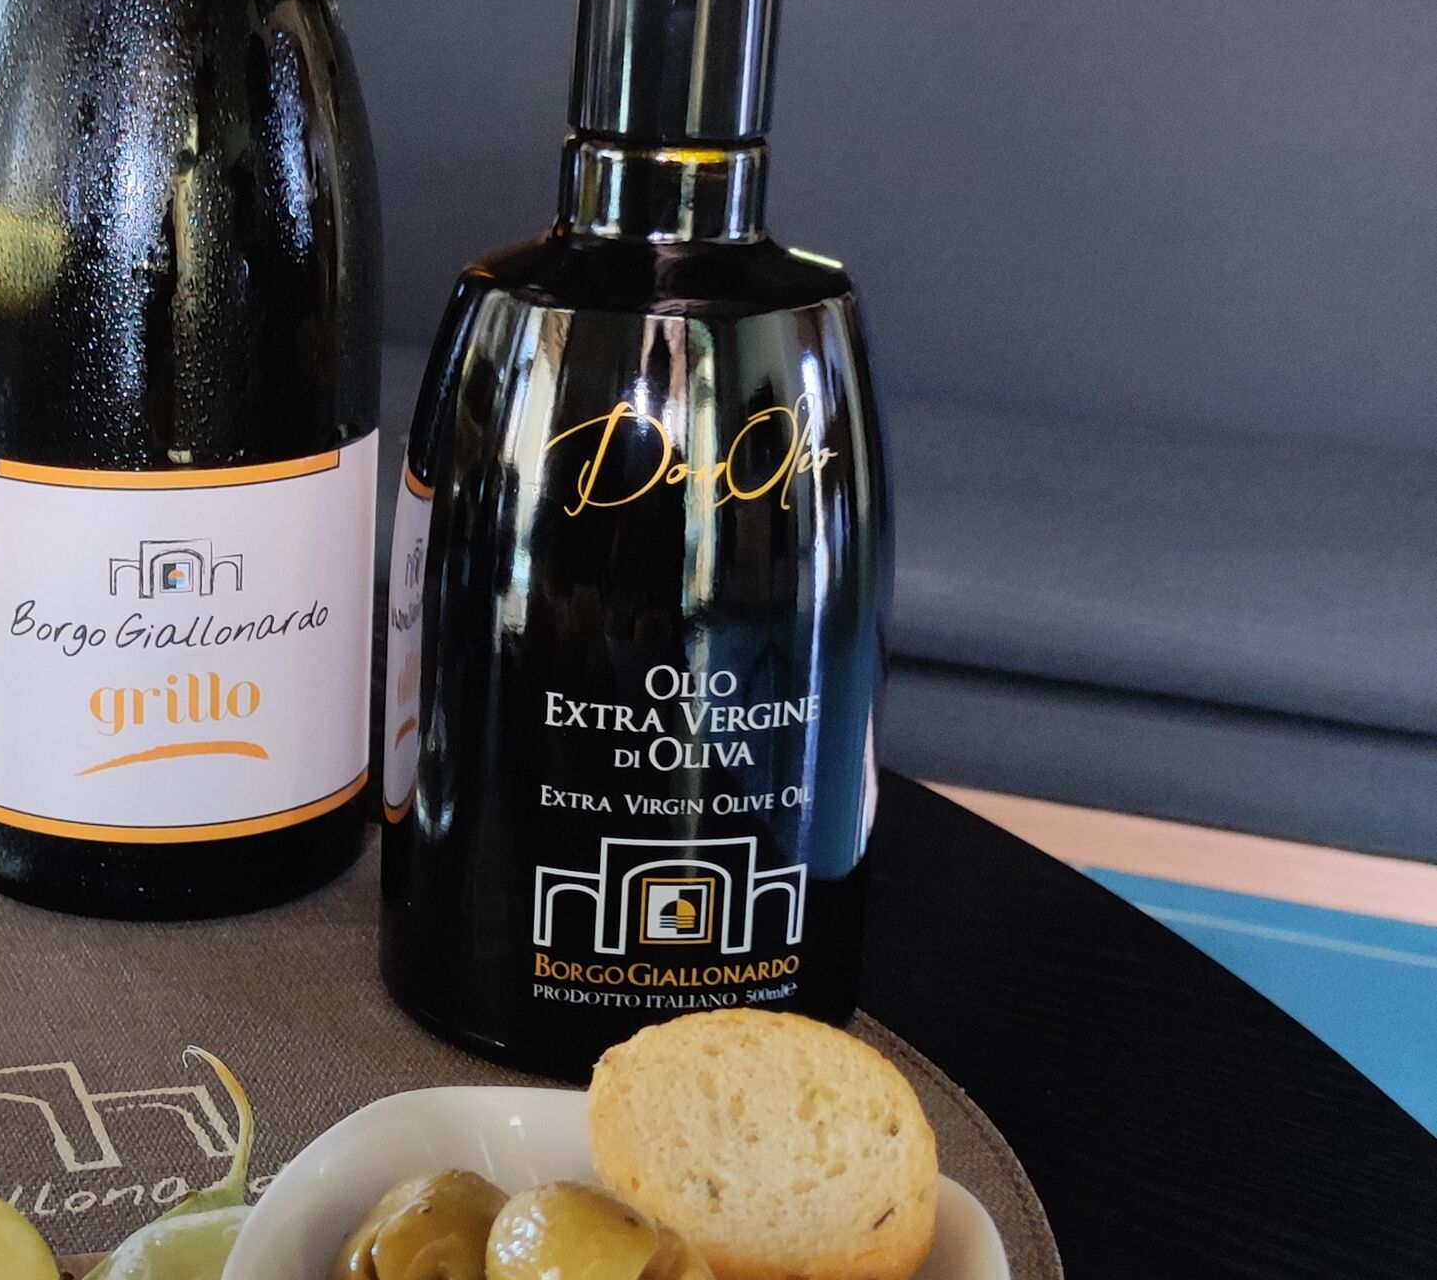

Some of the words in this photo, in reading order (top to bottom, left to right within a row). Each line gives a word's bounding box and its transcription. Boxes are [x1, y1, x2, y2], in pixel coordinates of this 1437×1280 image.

[10, 599, 106, 657] Borgo
[115, 600, 330, 649] Giallonardo
[645, 664, 737, 700] OLIO
[89, 671, 261, 736] grillo
[544, 691, 665, 733] EXTRA
[678, 695, 820, 736] VERGINE
[614, 748, 640, 769] DI
[648, 736, 755, 771] OLIVA
[540, 784, 613, 813] EXTRA
[623, 794, 705, 815] VIRGIN
[712, 793, 775, 814] OLIVE
[781, 785, 812, 808] OIL
[532, 983, 641, 1008] PRODOTTO
[646, 991, 737, 1008] ITALIANO
